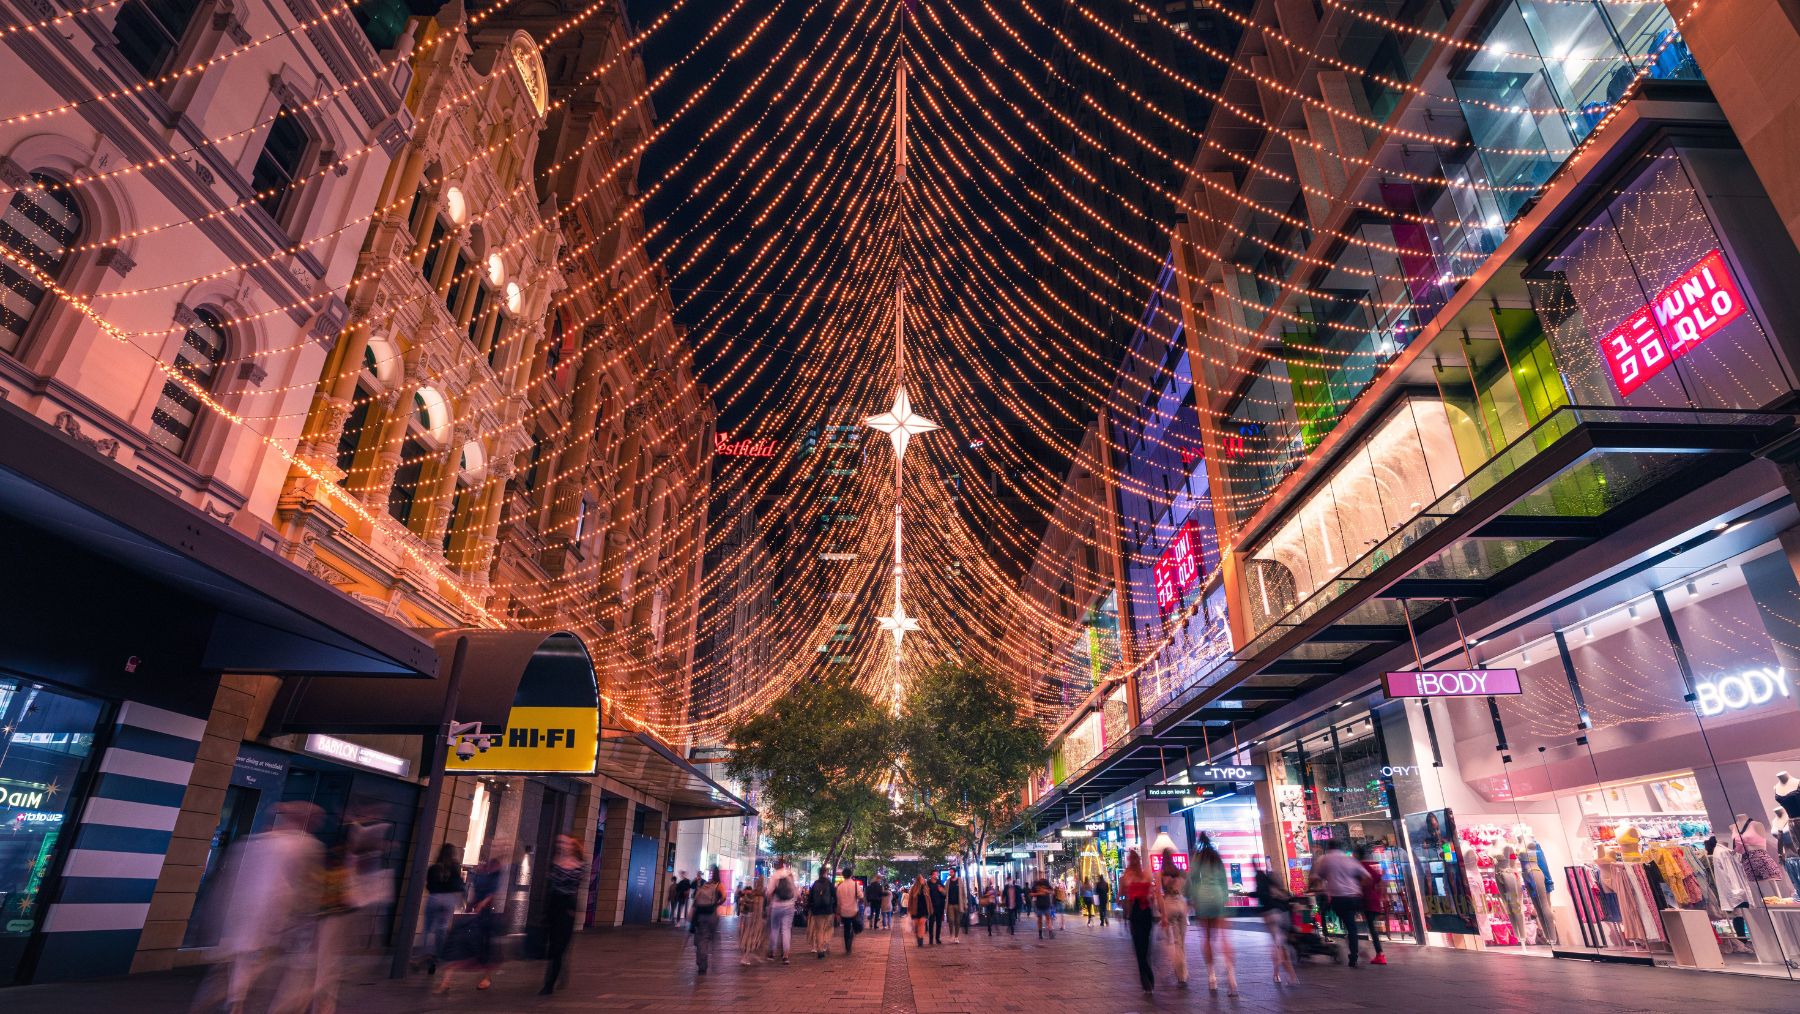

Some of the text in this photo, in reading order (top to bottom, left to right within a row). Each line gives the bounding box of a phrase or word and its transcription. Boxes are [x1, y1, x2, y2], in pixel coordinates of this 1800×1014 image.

[1666, 267, 1717, 318] UNI
[1677, 290, 1732, 342] QLO
[1175, 532, 1190, 563] UNI
[1178, 554, 1195, 587] QLO
[1421, 672, 1488, 695] BODY
[1696, 666, 1789, 716] BODY
[318, 737, 359, 761] BABYLON
[1085, 823, 1105, 831] rebel
